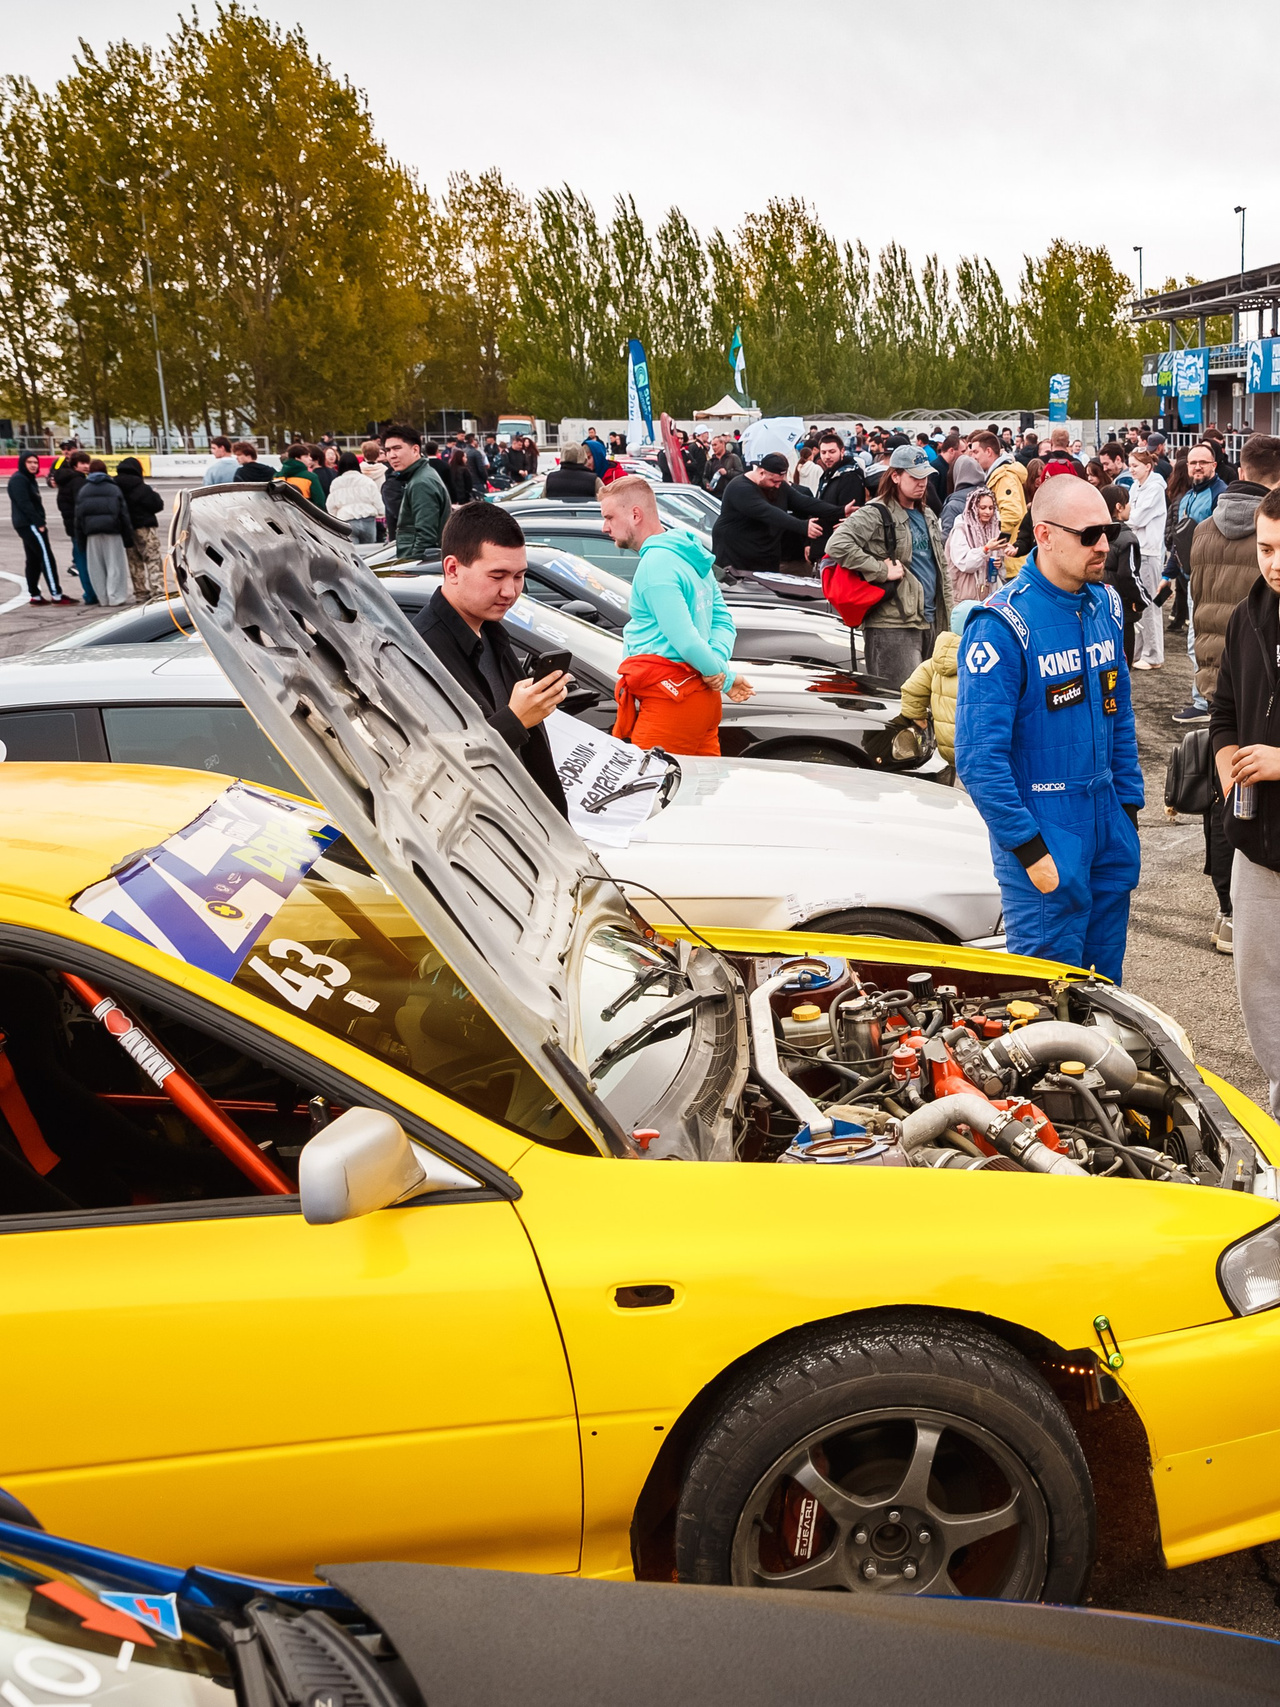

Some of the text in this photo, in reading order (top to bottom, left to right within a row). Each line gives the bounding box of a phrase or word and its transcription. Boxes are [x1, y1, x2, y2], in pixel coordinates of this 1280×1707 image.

[1001, 605, 1028, 638] sparco
[1037, 649, 1081, 678] KING
[1031, 782, 1066, 791] sparco
[248, 938, 352, 1011] 43
[92, 997, 176, 1089] I ANAL
[799, 1499, 815, 1558] SUBARU
